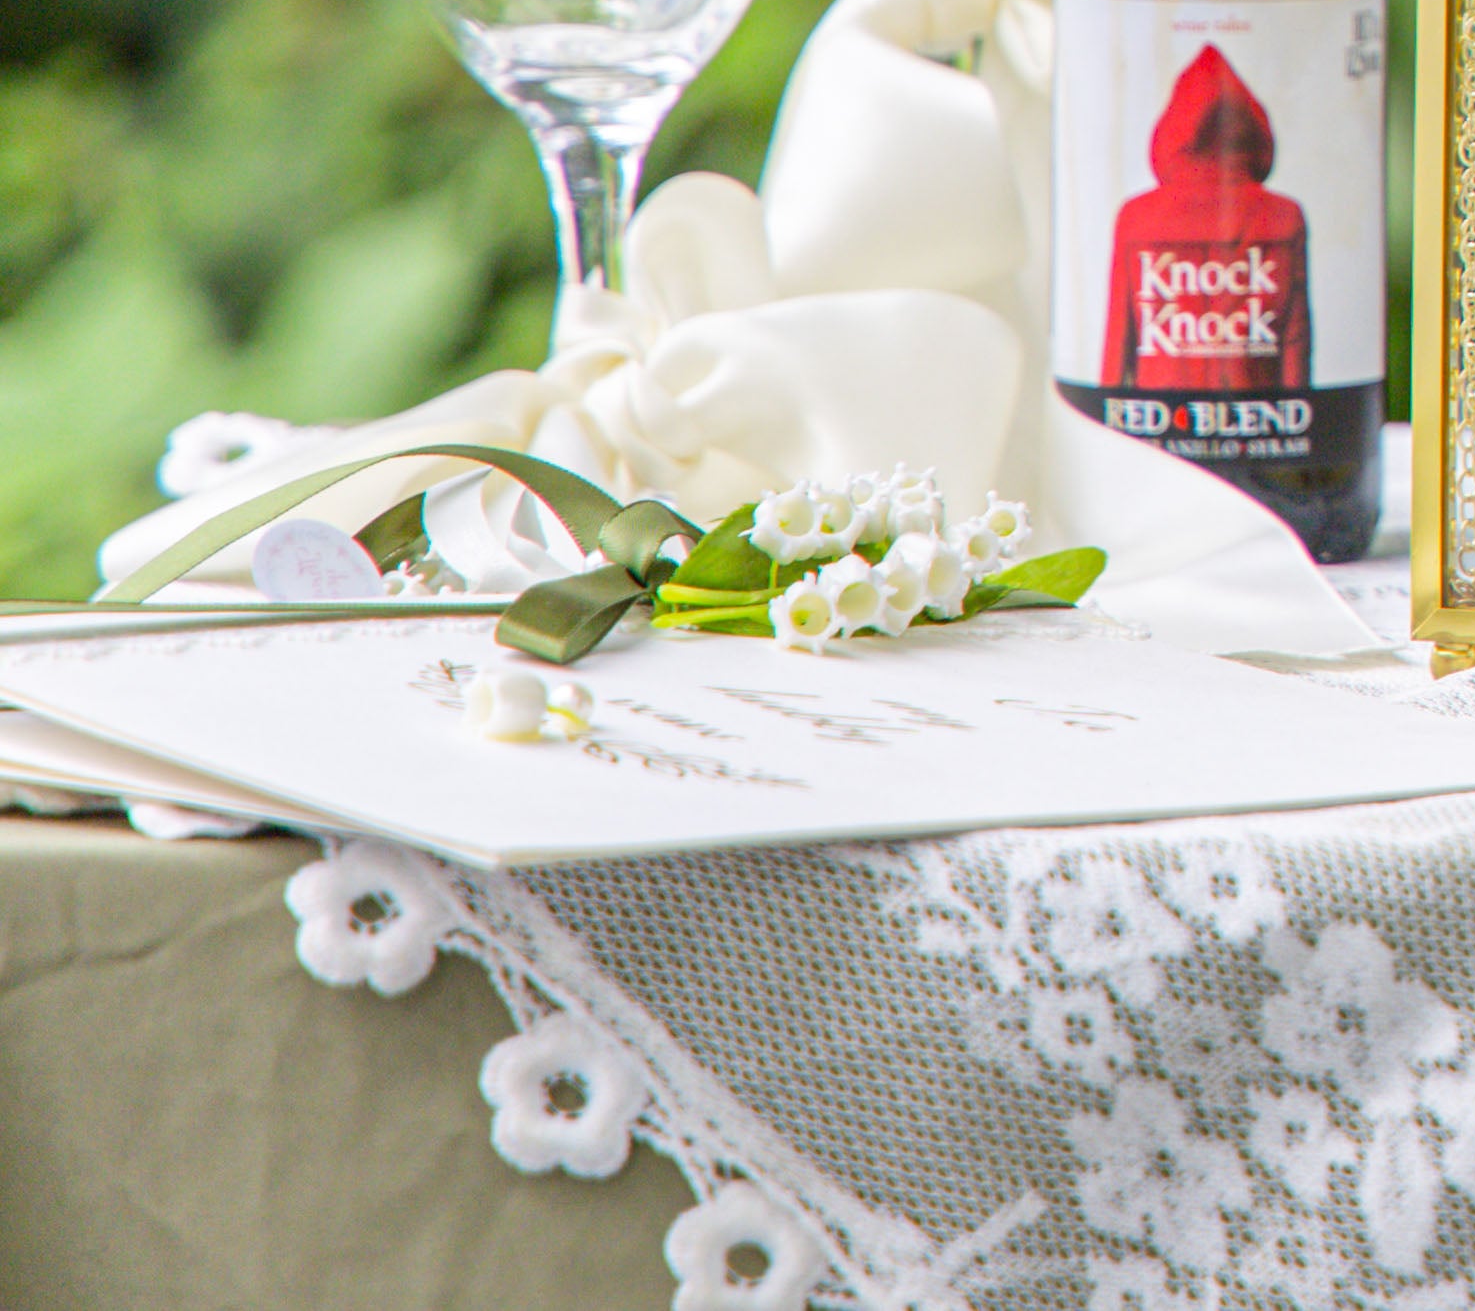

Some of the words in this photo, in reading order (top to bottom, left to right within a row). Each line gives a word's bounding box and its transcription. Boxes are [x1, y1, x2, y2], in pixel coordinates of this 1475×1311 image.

[1137, 246, 1278, 301] Knock
[1136, 297, 1278, 357] Knock
[1103, 397, 1171, 436] RED
[1187, 398, 1313, 438] BLEND
